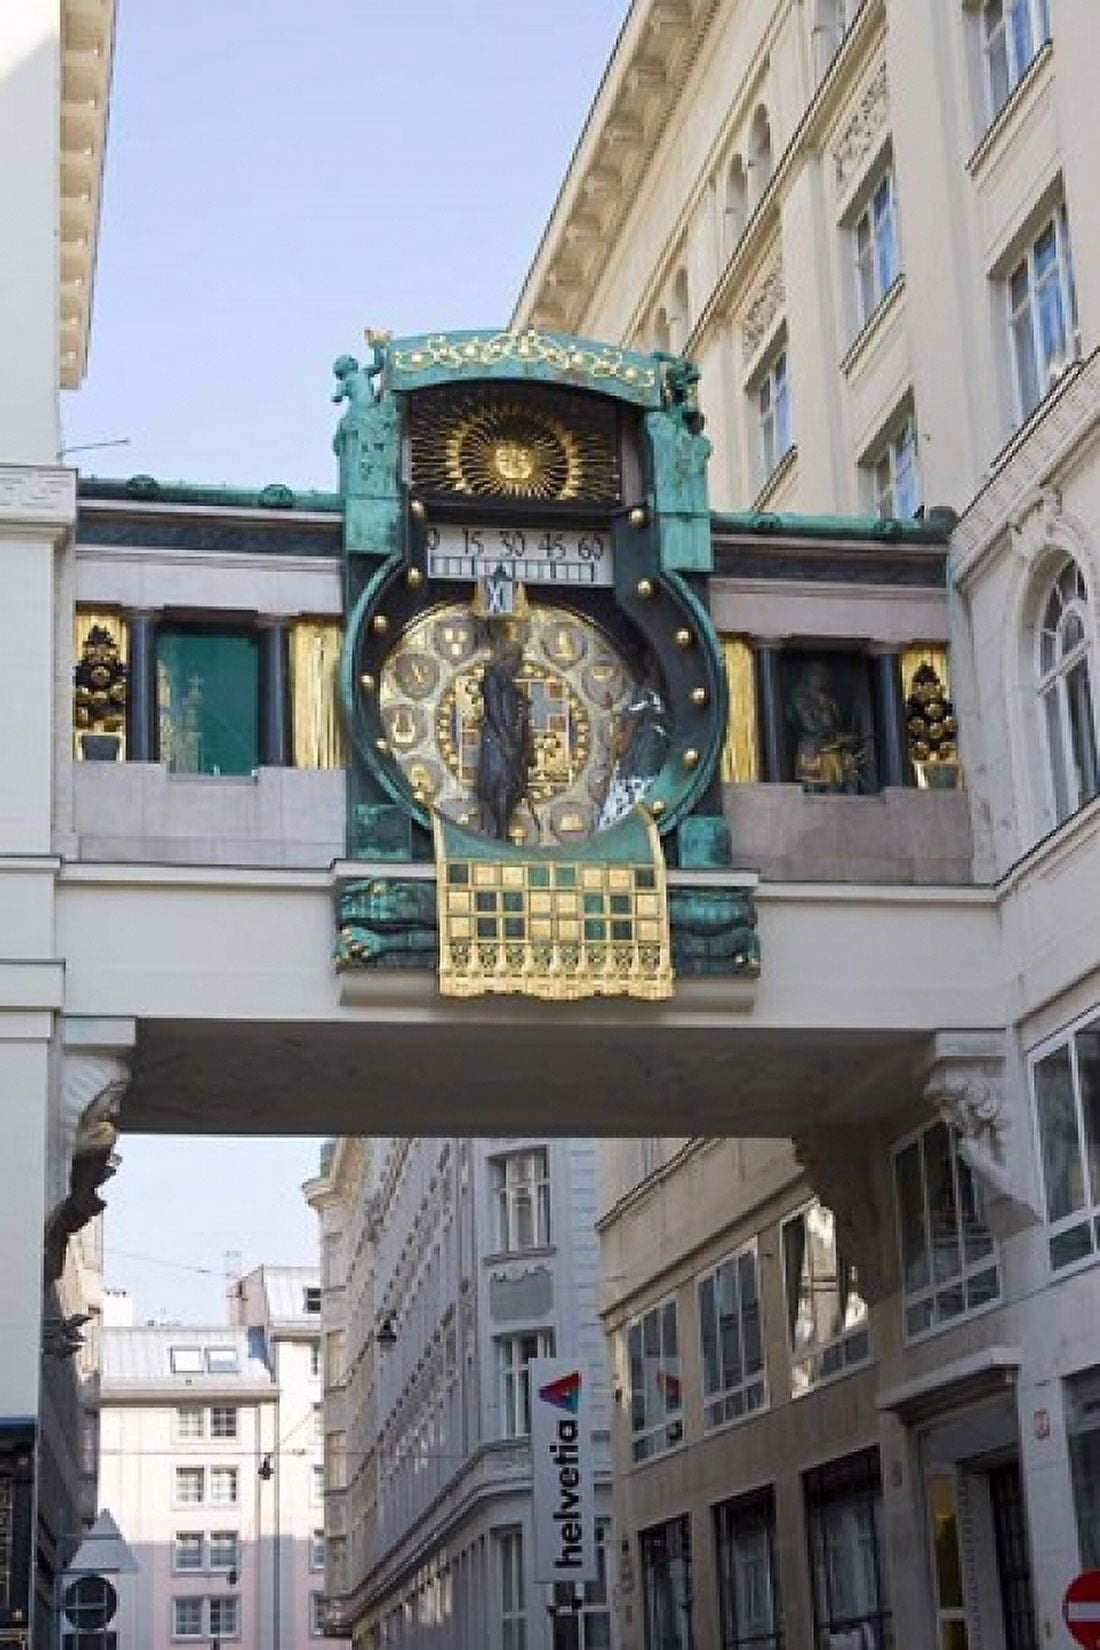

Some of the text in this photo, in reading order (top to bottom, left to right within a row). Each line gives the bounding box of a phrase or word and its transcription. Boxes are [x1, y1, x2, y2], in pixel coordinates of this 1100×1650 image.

[462, 527, 484, 555] 15
[499, 529, 525, 557] 30
[538, 532, 566, 560] 45
[578, 533, 604, 561] 60
[549, 1420, 582, 1568] helvetia
